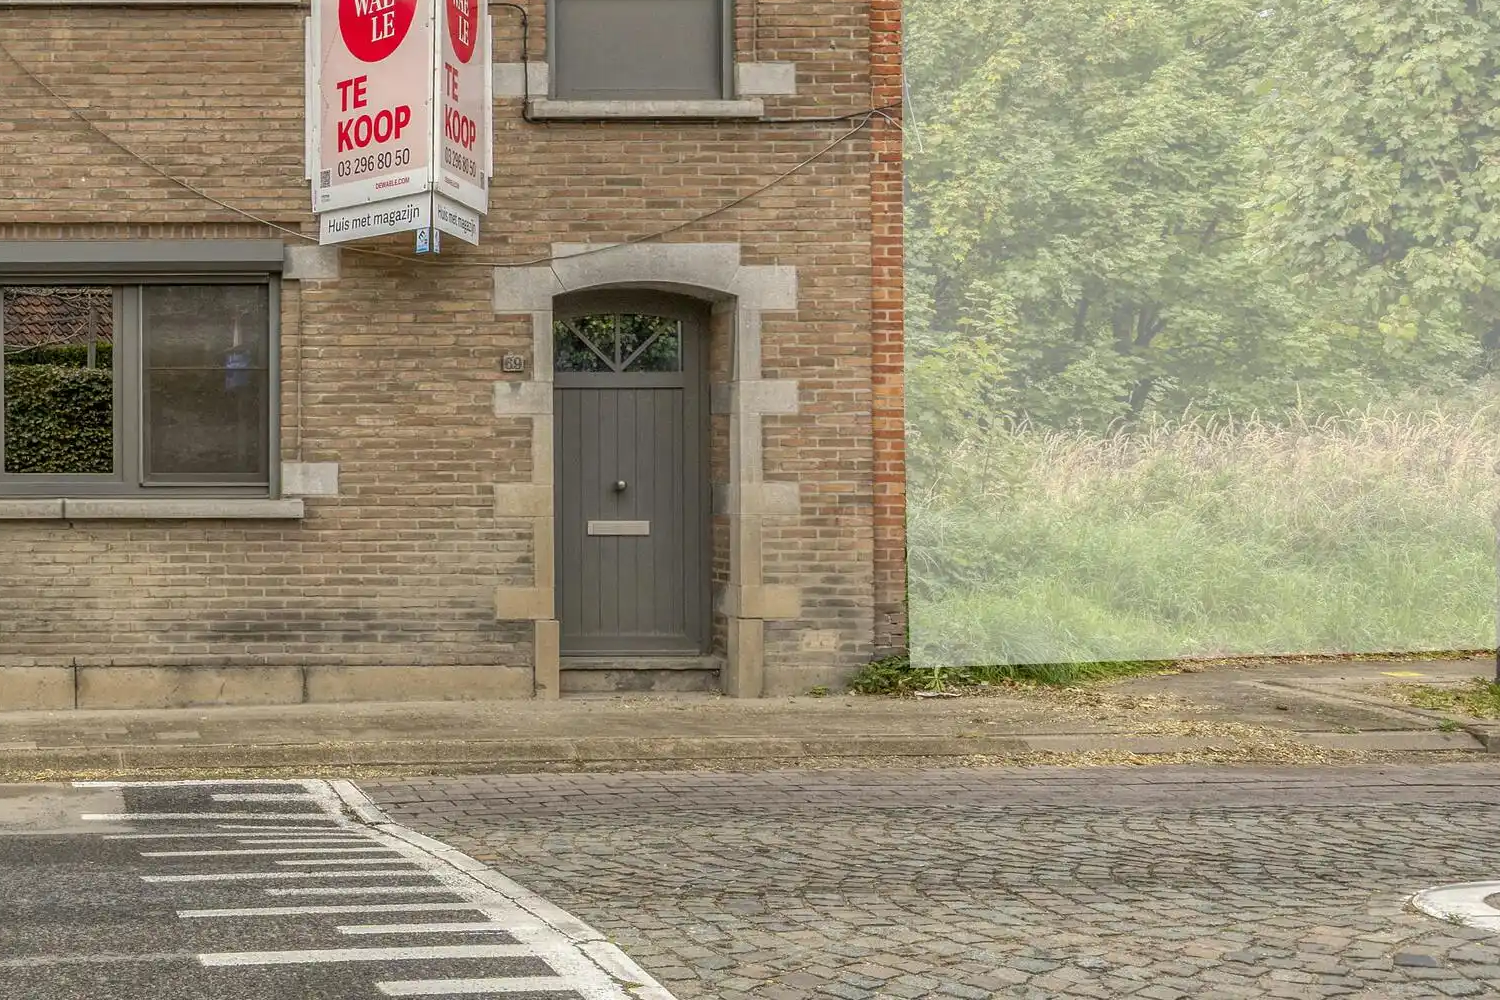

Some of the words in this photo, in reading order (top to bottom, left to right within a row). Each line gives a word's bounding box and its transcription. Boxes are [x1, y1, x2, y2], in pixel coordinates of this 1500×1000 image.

[371, 11, 395, 43] LE
[458, 15, 469, 46] LE
[336, 75, 368, 112] TE
[444, 62, 459, 102] TE
[337, 105, 411, 153] KOOP
[444, 104, 476, 152] KOOP
[338, 160, 351, 177] 03
[354, 155, 375, 174] 296
[377, 152, 392, 169] 80
[395, 148, 410, 166] 50
[444, 147, 451, 165] 03
[452, 150, 462, 170] 296
[462, 155, 469, 174] 80
[469, 161, 476, 178] 50
[375, 177, 410, 190] DEWAELE.COM
[328, 217, 350, 233] Huis
[352, 213, 371, 229] met
[374, 204, 420, 227] magazijn
[437, 204, 449, 222] Huis
[449, 212, 458, 226] met
[458, 217, 476, 237] magazijn
